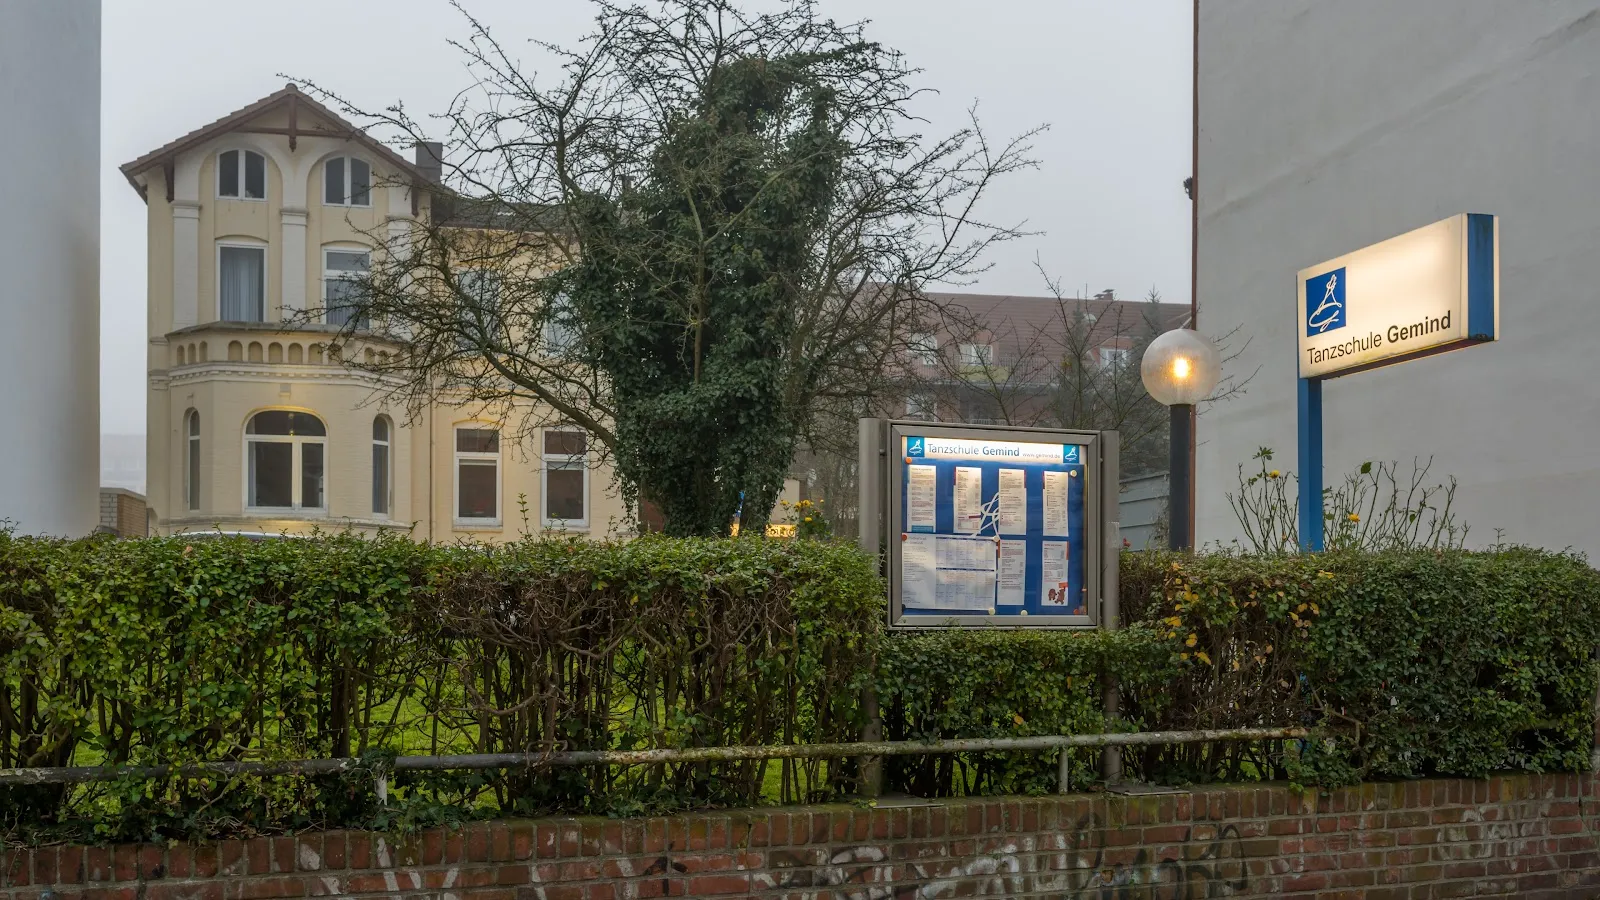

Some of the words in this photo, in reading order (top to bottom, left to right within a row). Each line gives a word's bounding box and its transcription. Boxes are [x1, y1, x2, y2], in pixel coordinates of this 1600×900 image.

[1307, 332, 1382, 365] Tanzschule
[1387, 310, 1451, 344] Gemind
[927, 443, 979, 455] Tanzschule
[982, 446, 1020, 457] Gemind
